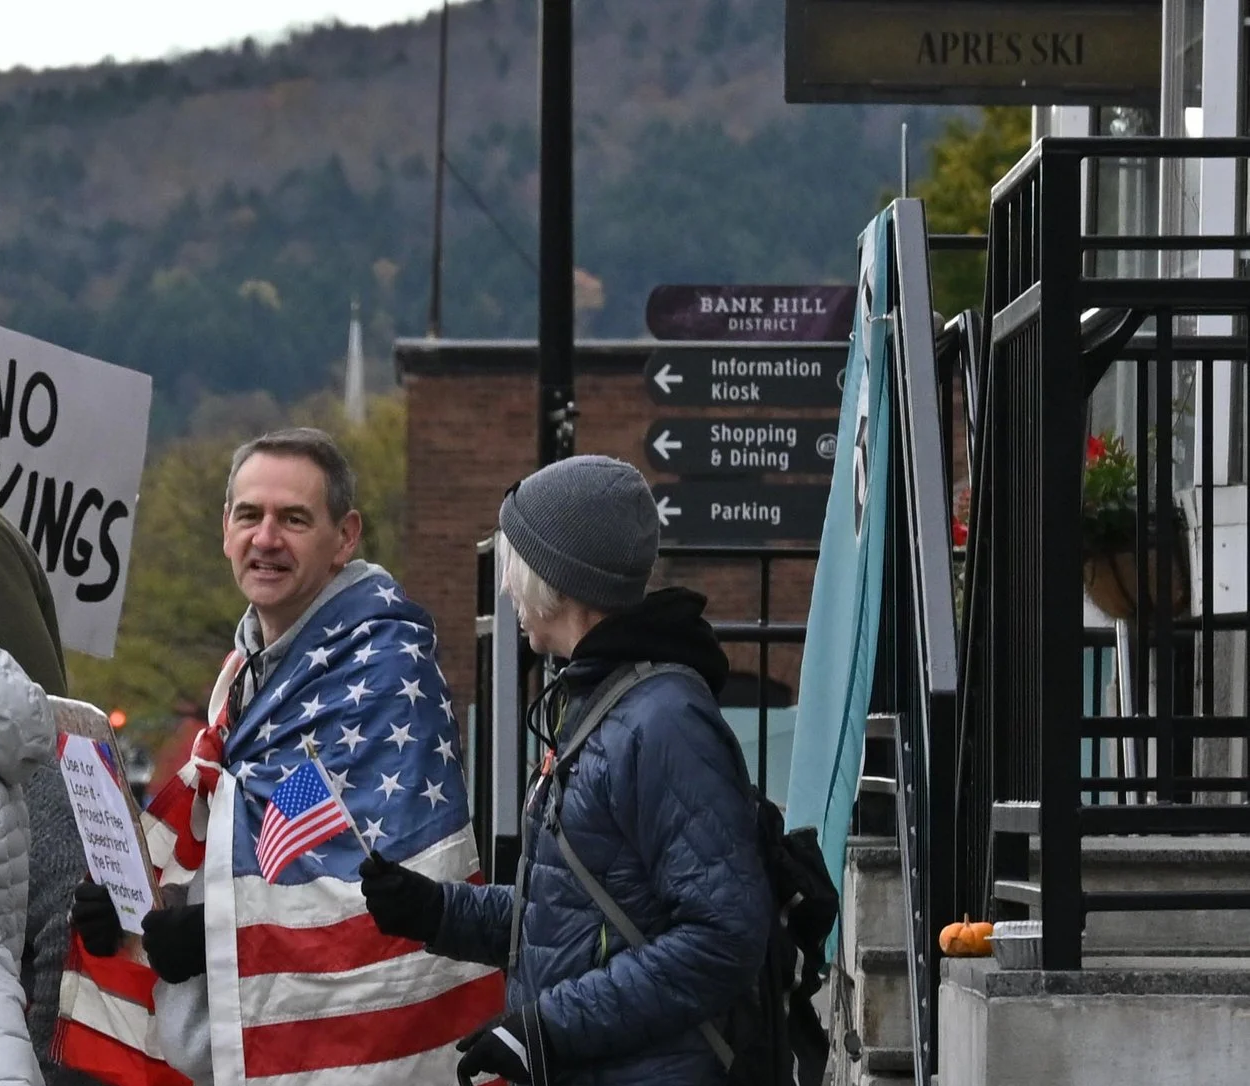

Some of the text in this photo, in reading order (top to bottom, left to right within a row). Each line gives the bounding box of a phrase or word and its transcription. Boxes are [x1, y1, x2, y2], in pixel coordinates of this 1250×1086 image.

[917, 31, 1084, 66] APRES SKI
[700, 296, 827, 314] BANK HILL
[728, 317, 796, 332] DISTRICT
[710, 357, 822, 377] Information
[710, 381, 760, 401] Kiosk
[710, 424, 797, 449] Shopping
[710, 448, 789, 471] & Dining
[710, 501, 781, 526] Parking
[104, 810, 123, 830] Free
